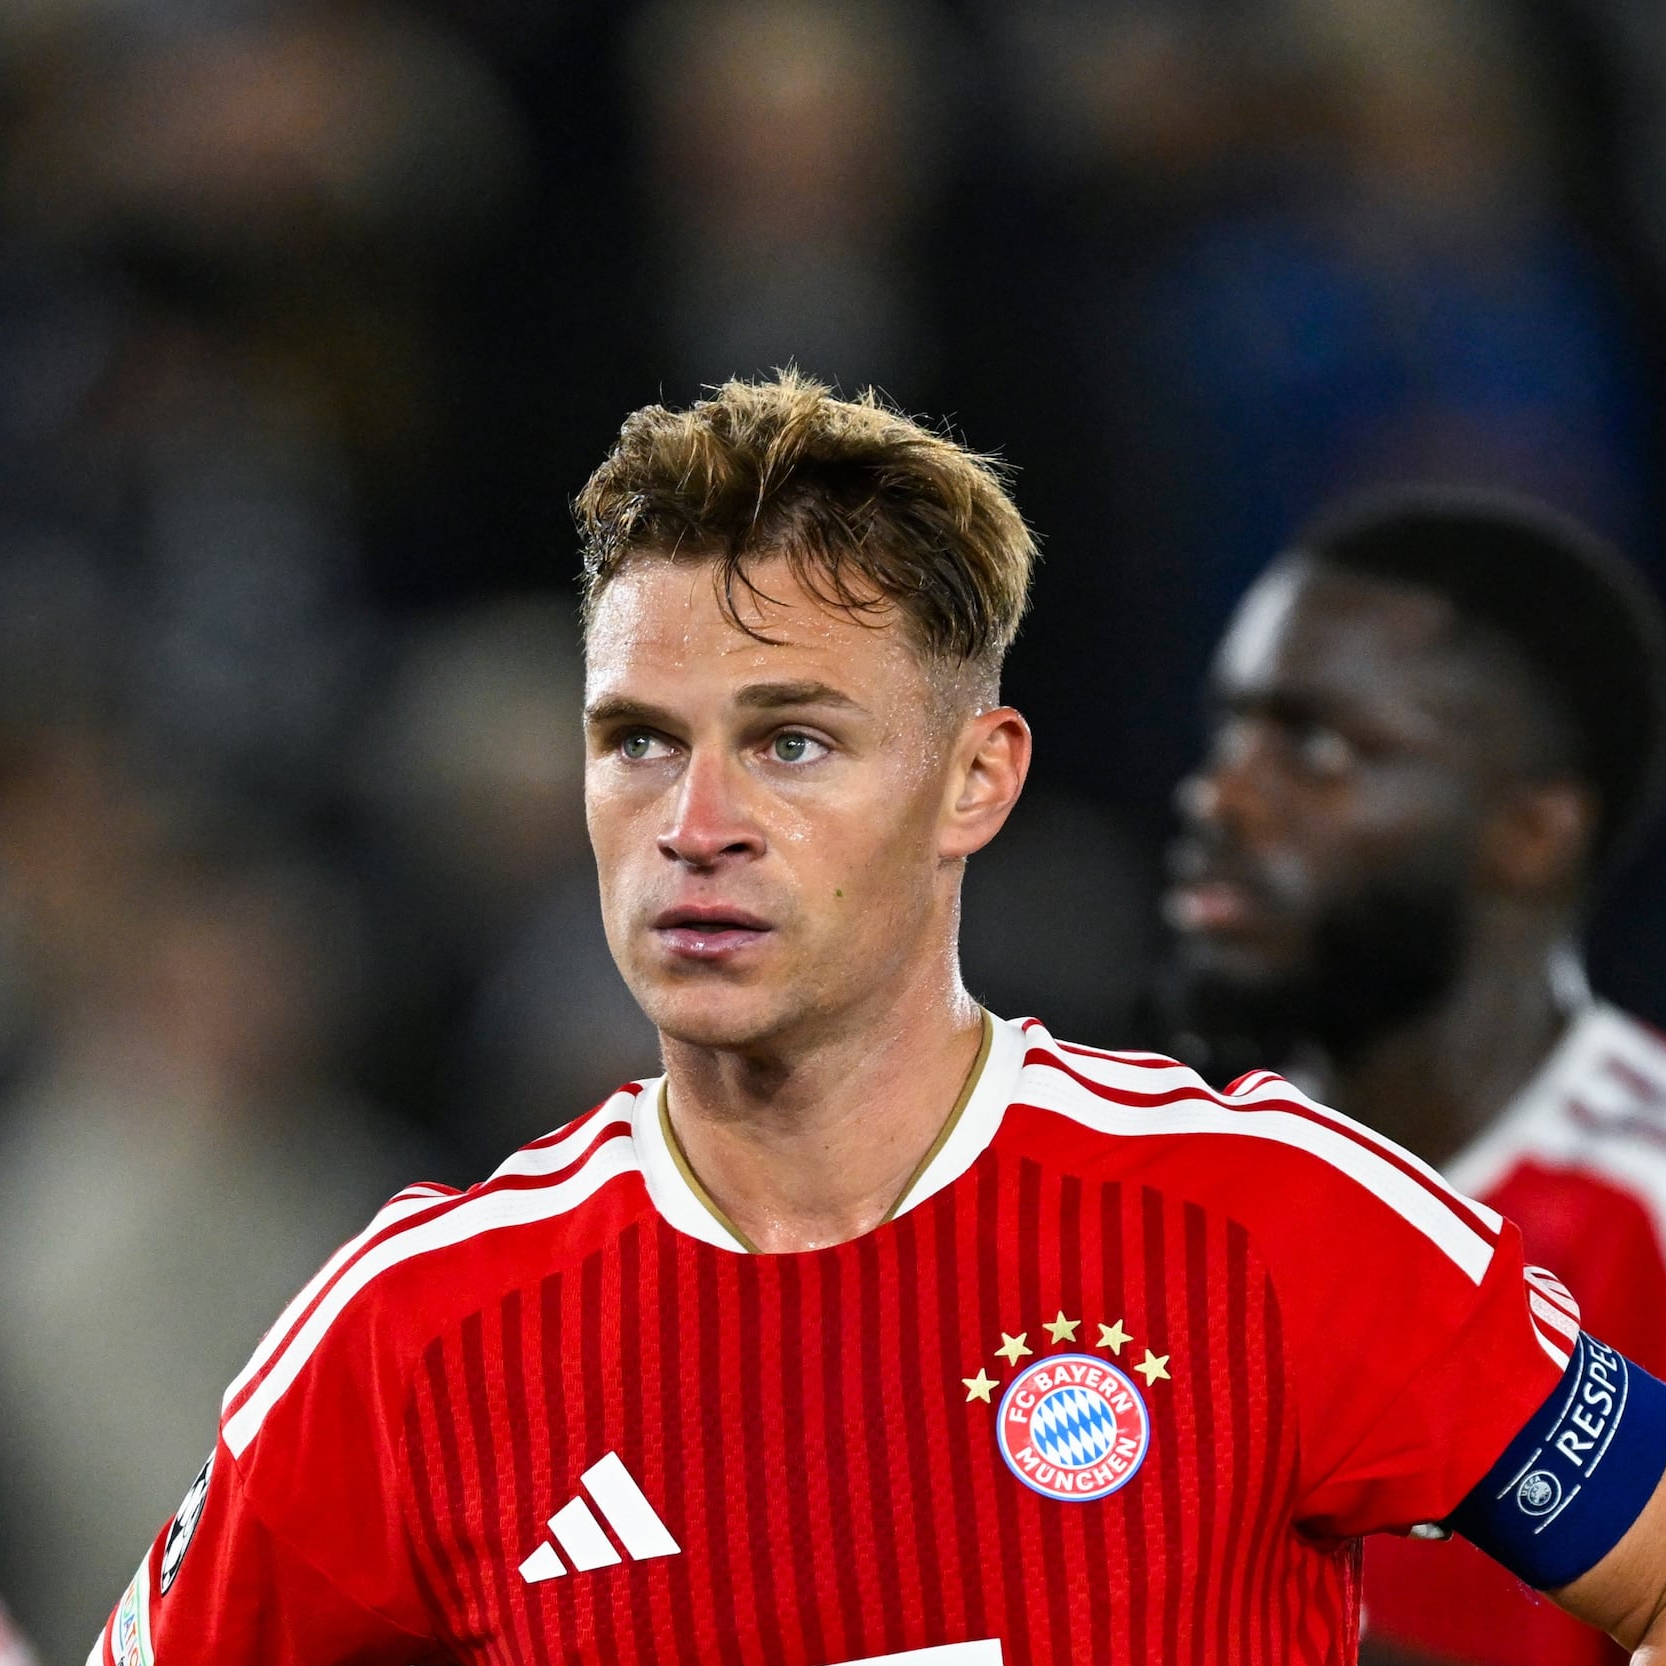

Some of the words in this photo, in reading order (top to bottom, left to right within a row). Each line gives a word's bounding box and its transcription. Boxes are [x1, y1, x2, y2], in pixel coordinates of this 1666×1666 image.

[1008, 1390, 1035, 1424] FC
[1033, 1364, 1133, 1414] BAYERN
[1014, 1436, 1137, 1491] MÜNCHEN
